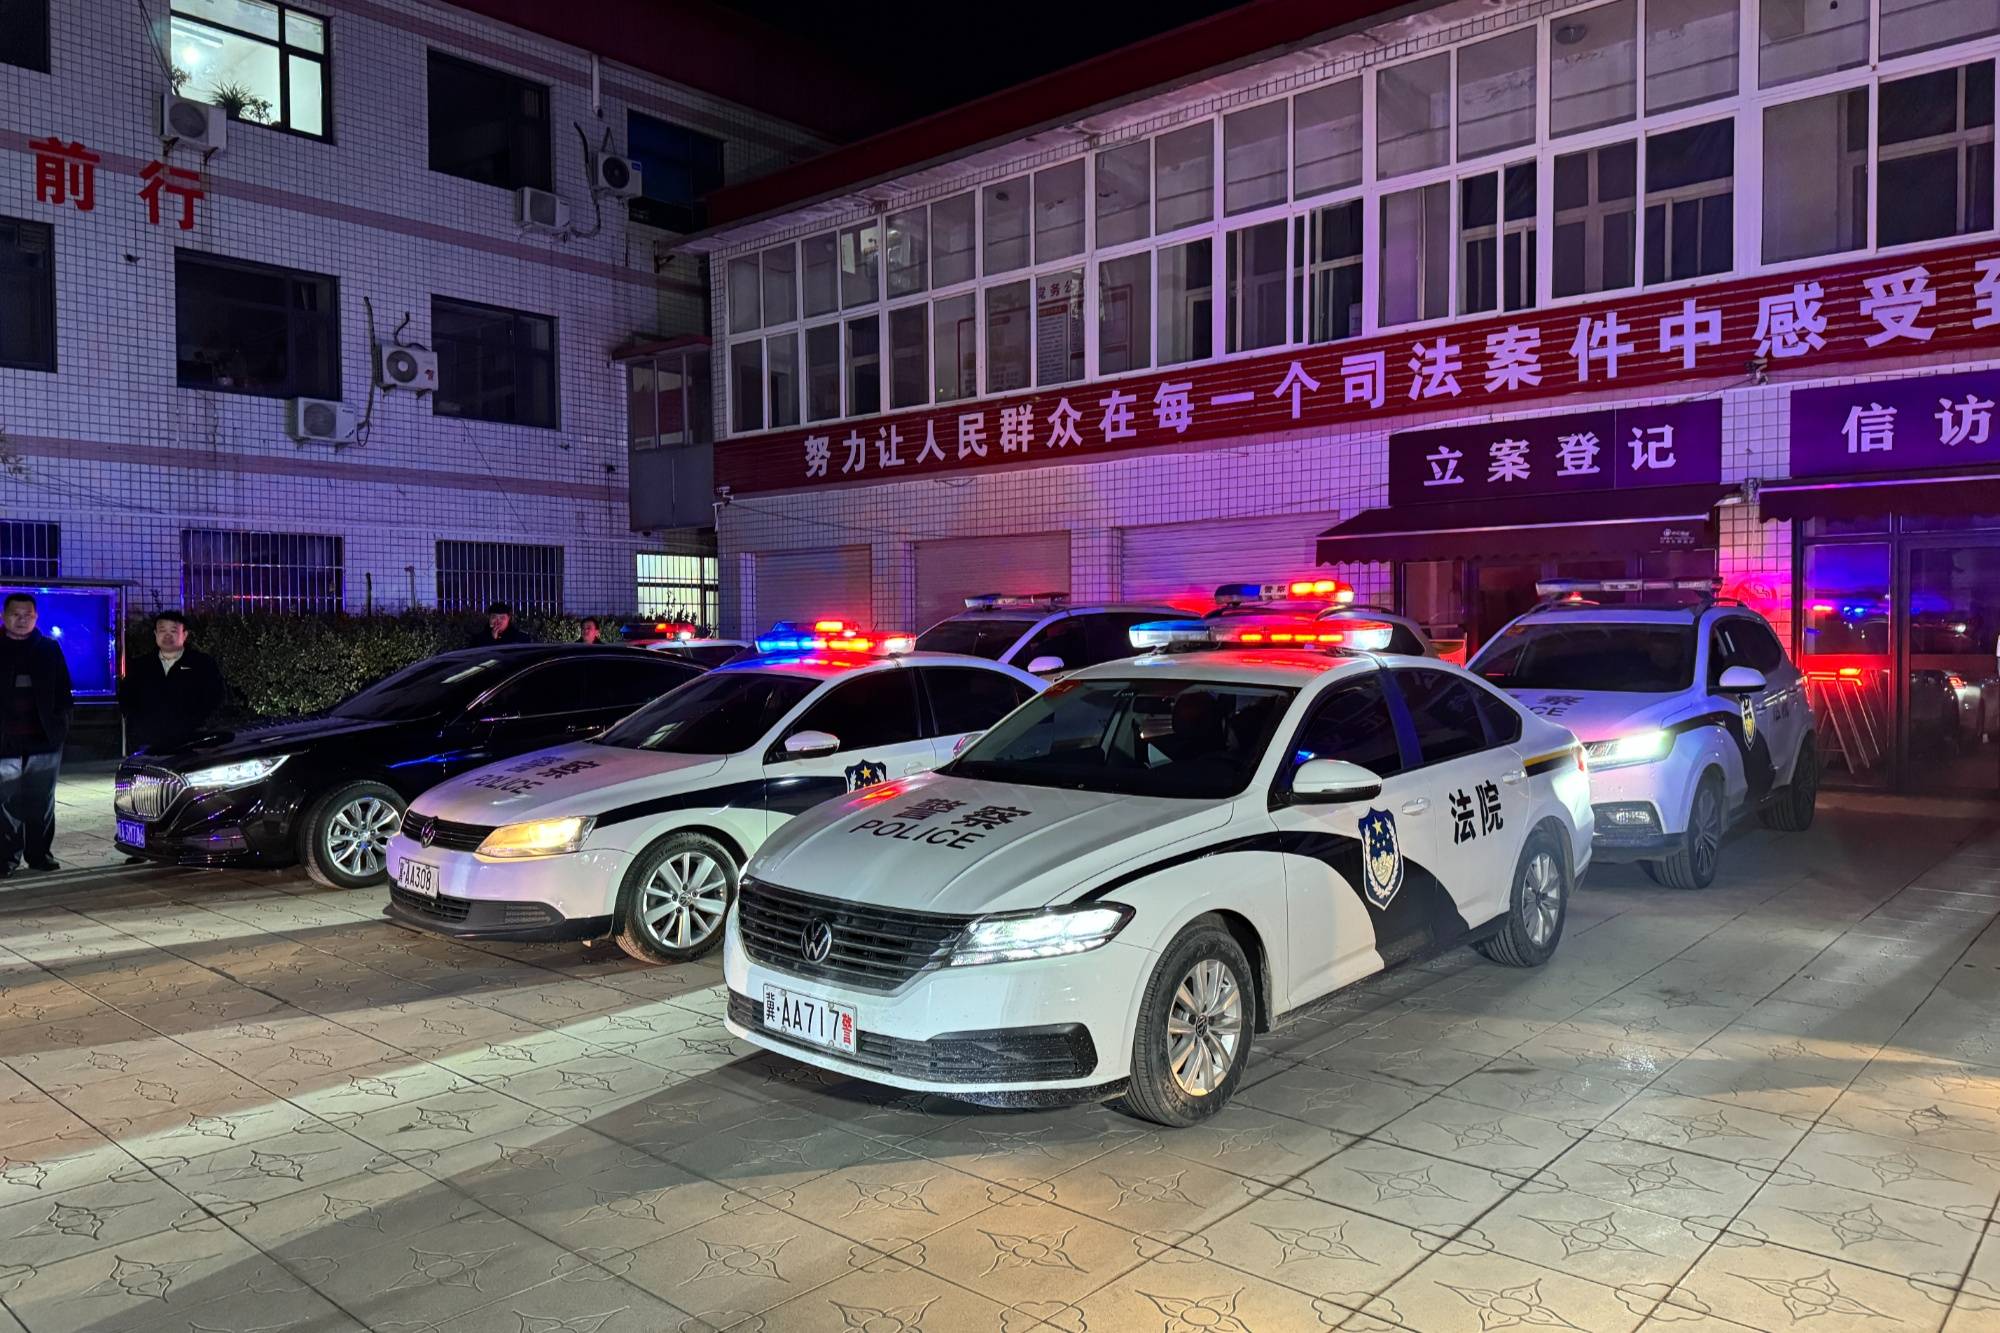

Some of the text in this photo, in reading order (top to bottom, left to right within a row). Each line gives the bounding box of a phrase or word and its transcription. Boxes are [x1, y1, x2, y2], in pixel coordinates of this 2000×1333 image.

[29, 137, 205, 230] 前行
[1841, 394, 1996, 453] 信访
[1423, 423, 1676, 487] 立案登记
[464, 774, 545, 794] POLICE
[1448, 780, 1504, 844] 法院
[849, 819, 986, 849] POLICE
[892, 798, 1032, 830] 警察
